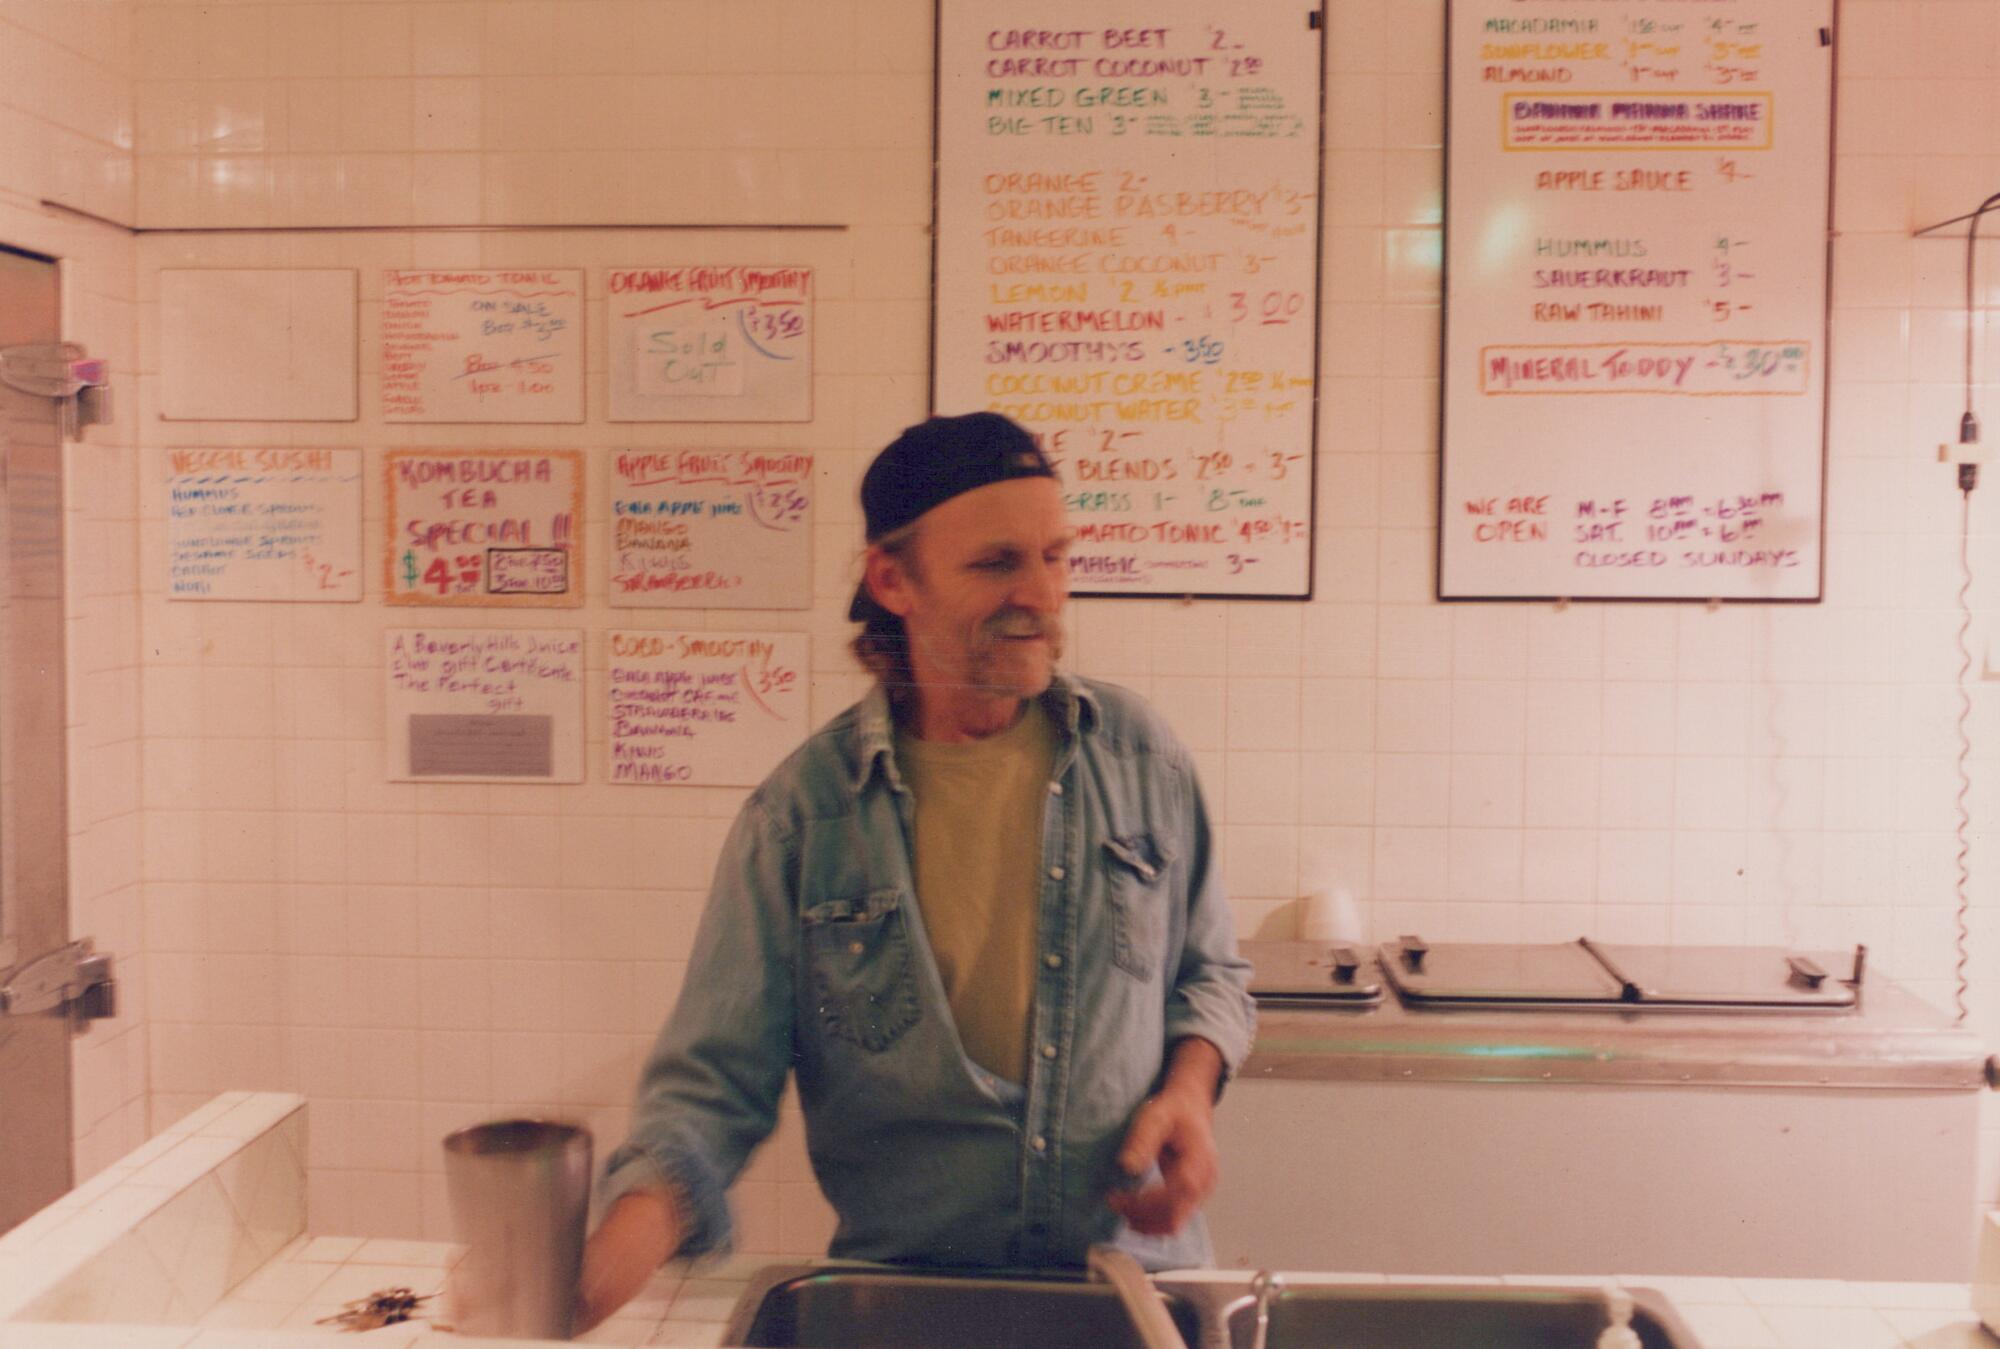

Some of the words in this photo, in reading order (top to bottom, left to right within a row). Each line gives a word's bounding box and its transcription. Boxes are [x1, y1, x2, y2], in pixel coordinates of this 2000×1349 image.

[1485, 17, 1600, 34] MACADAMIA
[987, 29, 1092, 52] CARROT
[1104, 28, 1172, 50] BEET
[1480, 42, 1613, 61] SUNFLOWER
[986, 57, 1092, 79] CARROT
[1095, 57, 1212, 79] COCONUT
[1481, 66, 1573, 84] ALMOND
[986, 87, 1065, 109] MIXED
[1075, 87, 1168, 109] GREEN
[987, 115, 1038, 136] BIG
[1042, 116, 1094, 136] TEN
[984, 171, 1103, 195] ORANGE
[1536, 169, 1604, 193] APPLE
[1612, 168, 1695, 192] SAUCE
[985, 197, 1102, 221] ORANGE
[983, 225, 1131, 248] TANGERINE
[1536, 236, 1650, 258] HUMMUS
[988, 253, 1093, 276] ORANGE
[1099, 253, 1226, 275] COCONUT
[609, 269, 685, 294] ORANGE
[687, 267, 735, 293] FRUIT
[1533, 268, 1693, 290] SAUERKRAUT
[989, 281, 1089, 304] LEMON
[985, 309, 1165, 334] WATERMELON
[1532, 301, 1581, 322] RAW
[1586, 302, 1664, 322] TAHINI
[1489, 355, 1597, 388] MINERAL
[985, 371, 1110, 397] COCONUT
[1112, 370, 1203, 395] CREME
[1116, 399, 1204, 423] WATER
[255, 450, 333, 472] SUSHI
[1076, 458, 1178, 481] BLENDS
[398, 458, 552, 489] KOMBUCHA
[442, 488, 498, 509] TEA
[1464, 498, 1500, 517] WE
[1505, 495, 1551, 516] ARE
[406, 517, 545, 552] SPECIAL
[1151, 519, 1229, 545] TONIC
[1473, 521, 1549, 544] OPEN
[1068, 554, 1143, 576] MAGIC
[1573, 550, 1668, 568] CLOSED
[1682, 549, 1800, 568] SUNDAYS
[614, 761, 692, 781] MANGO
